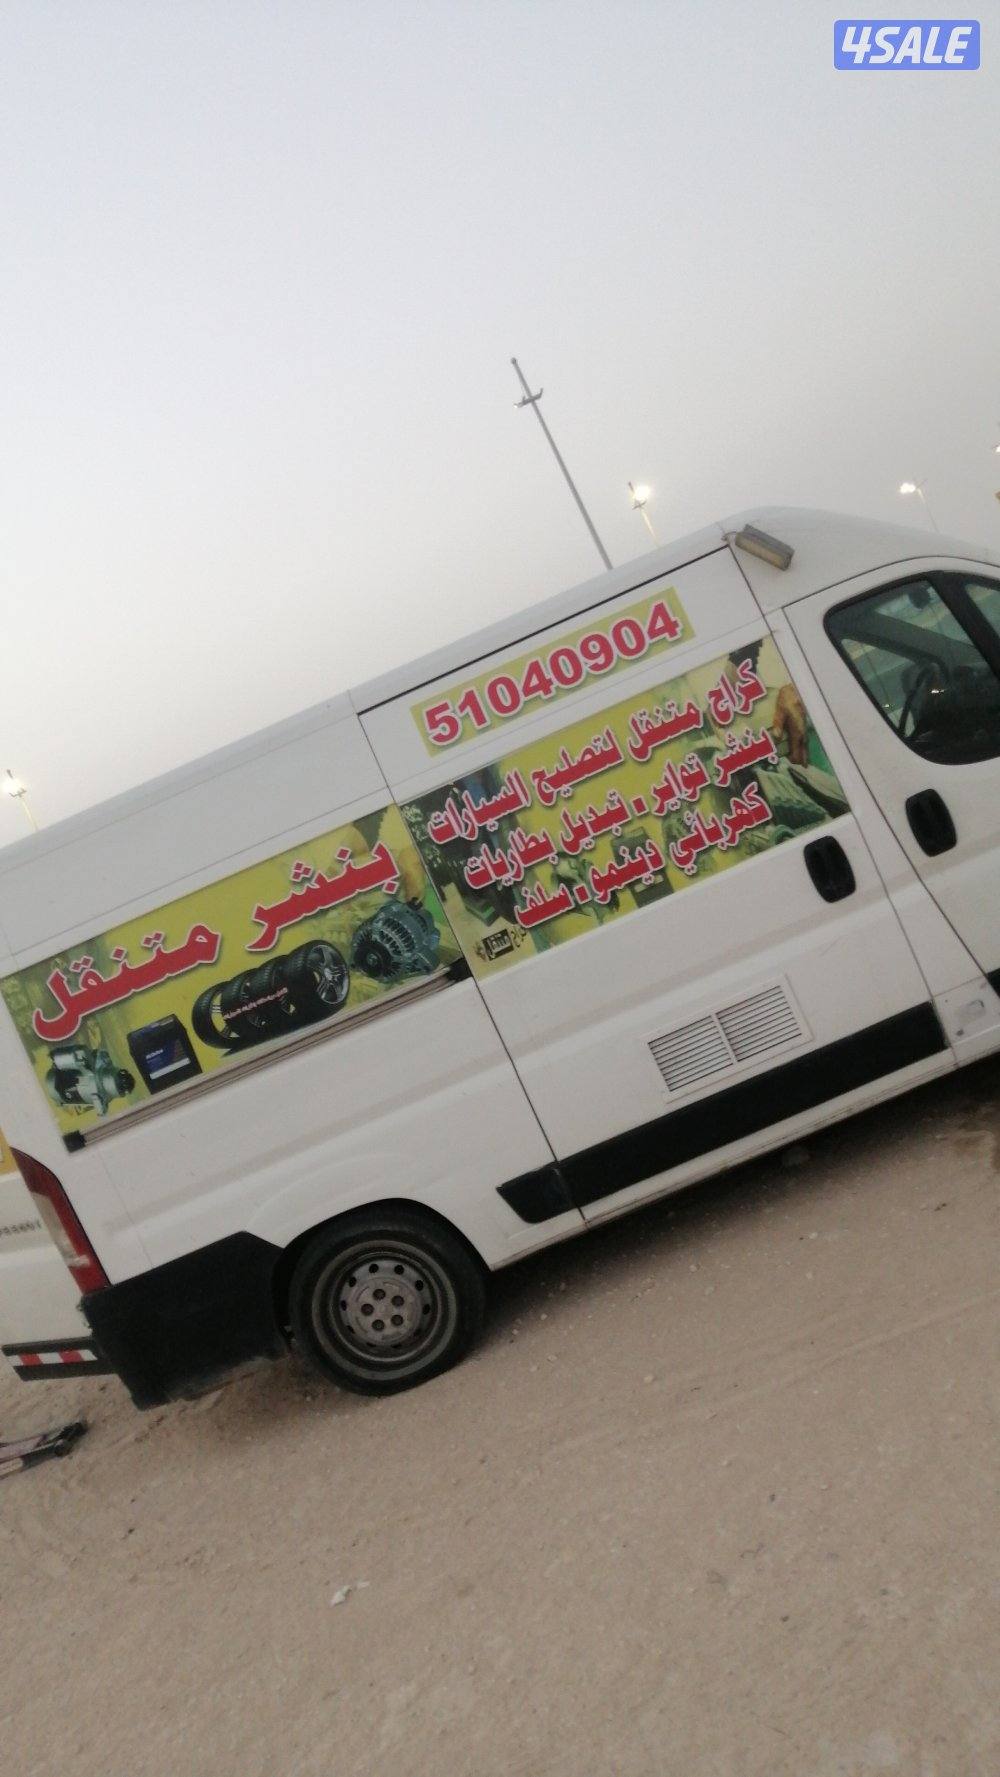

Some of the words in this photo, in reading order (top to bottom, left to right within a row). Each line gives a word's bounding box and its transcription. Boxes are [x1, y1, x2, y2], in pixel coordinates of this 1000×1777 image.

[424, 600, 681, 746] 51040904
[706, 658, 767, 725] كراج
[529, 727, 624, 806] لتصليح
[628, 699, 704, 763] متنقل
[714, 726, 779, 787] بنشر
[427, 767, 532, 845] السيارات
[559, 788, 631, 855] تبديل
[668, 781, 773, 875] كهربائي
[464, 826, 560, 889] بطاريات
[245, 842, 400, 952] بنشر
[513, 880, 575, 929] سلف
[32, 922, 221, 1042] متنقل
